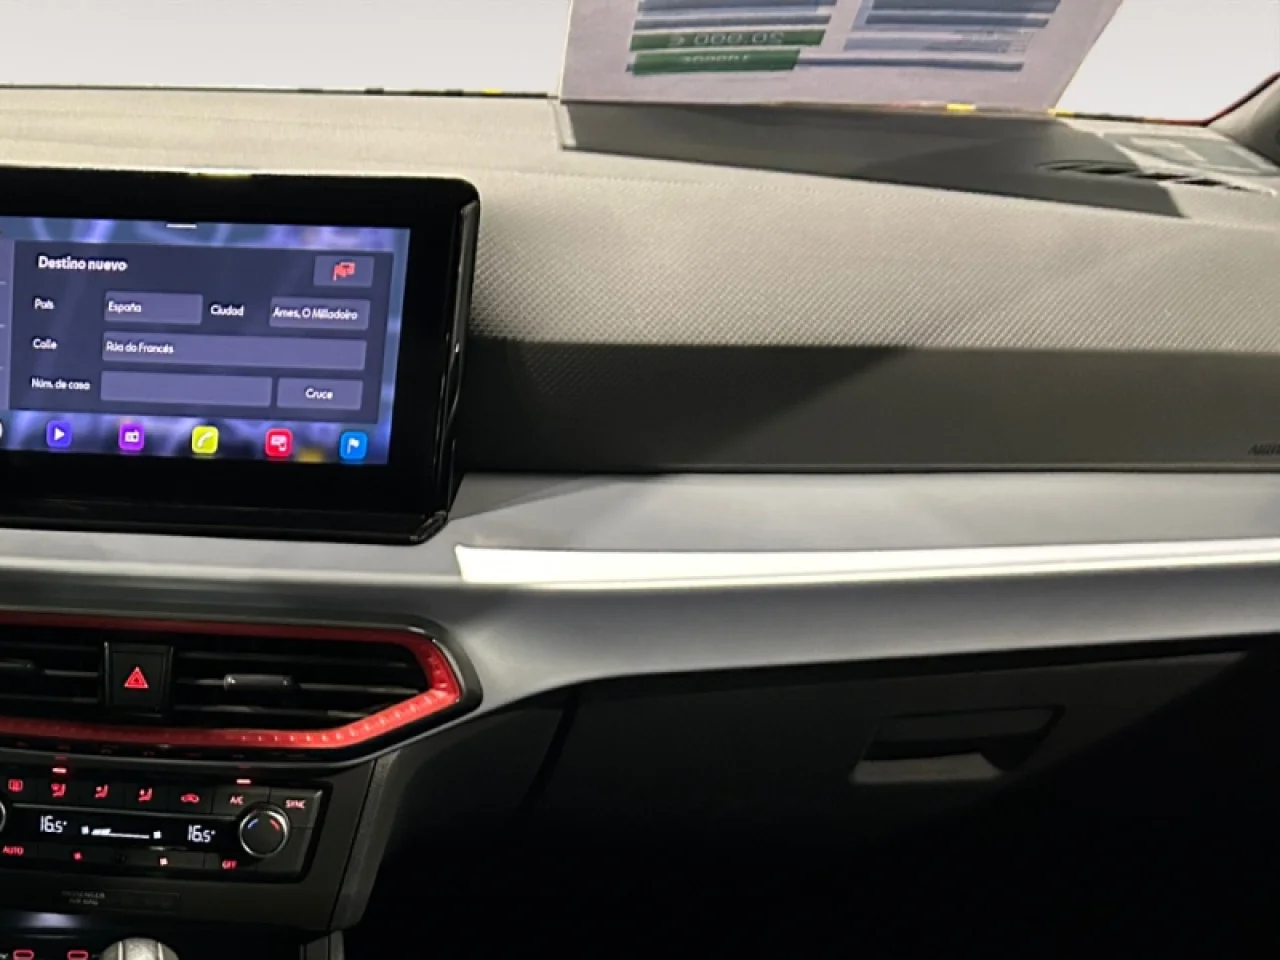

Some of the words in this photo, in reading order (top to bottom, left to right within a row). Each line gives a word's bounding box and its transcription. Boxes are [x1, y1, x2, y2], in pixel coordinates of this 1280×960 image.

[37, 256, 87, 270] Destino
[87, 259, 128, 271] nuevo
[108, 301, 142, 313] España
[210, 304, 245, 317] Ciudad
[312, 309, 358, 320] Milladoiro
[32, 338, 58, 350] Calle
[31, 377, 54, 389] Núm.
[55, 379, 67, 389] de
[68, 381, 90, 390] casa
[305, 388, 333, 400] Cruce
[229, 795, 244, 805] A/C
[285, 799, 307, 809] SYNC
[2, 845, 25, 856] AUTO
[221, 859, 238, 870] OFF
